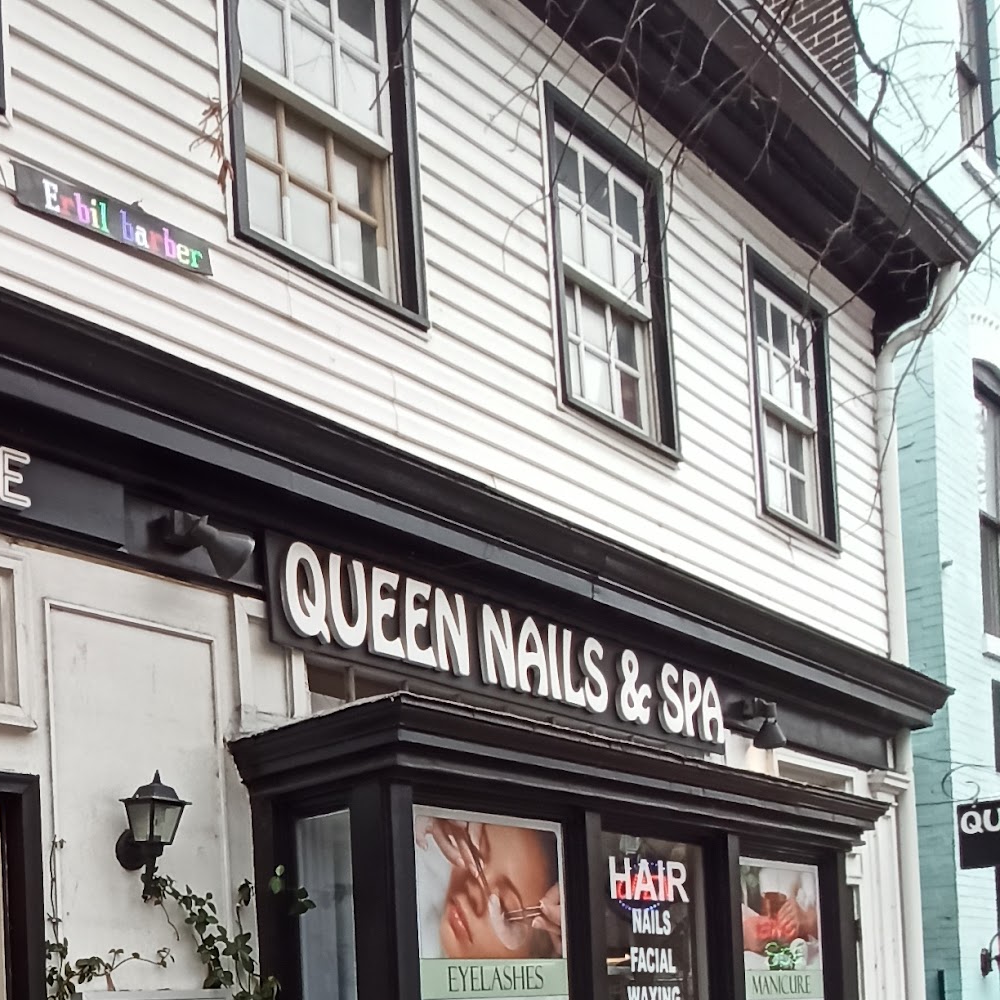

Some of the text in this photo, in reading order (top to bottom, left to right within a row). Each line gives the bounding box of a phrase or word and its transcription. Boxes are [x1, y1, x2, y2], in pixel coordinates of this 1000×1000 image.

[42, 178, 203, 268] Erbil barber
[283, 541, 725, 745] QUEEN NAILS & SPA
[609, 856, 690, 902] HAIR
[632, 908, 671, 936] NAILS
[630, 947, 677, 974] FACIAL
[447, 965, 545, 992] EYELASHES
[752, 974, 812, 995] MANICURE
